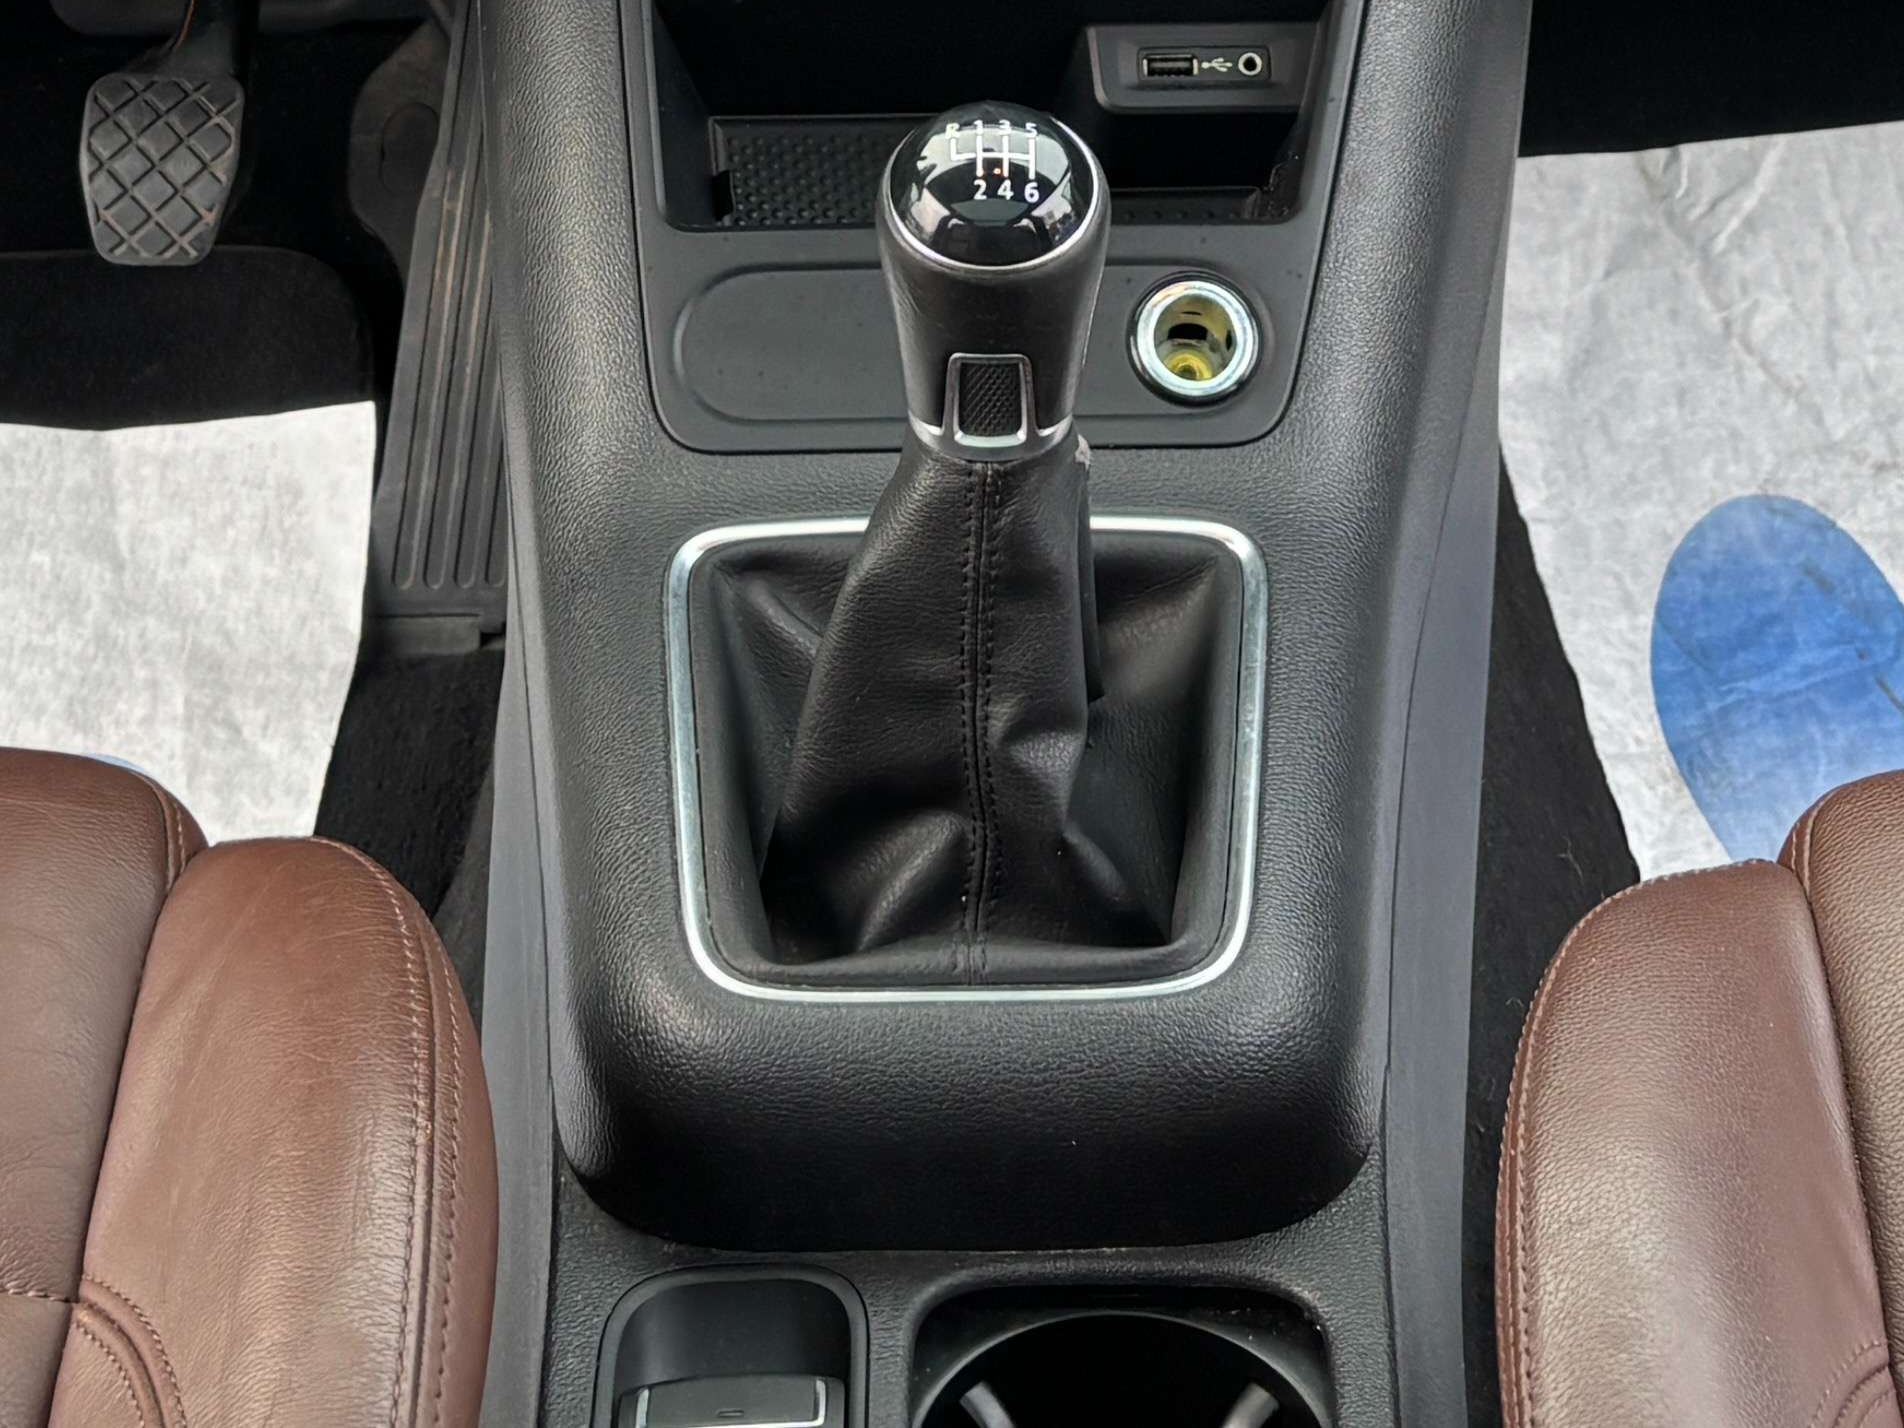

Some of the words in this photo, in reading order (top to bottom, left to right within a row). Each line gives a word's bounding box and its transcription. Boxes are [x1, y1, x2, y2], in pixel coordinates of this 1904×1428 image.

[944, 121, 962, 140] R
[973, 119, 984, 136] 1
[999, 119, 1013, 136] 3
[1025, 122, 1039, 139] 5
[974, 179, 988, 201] 2
[997, 179, 1015, 201] 4
[1024, 182, 1040, 204] 6
